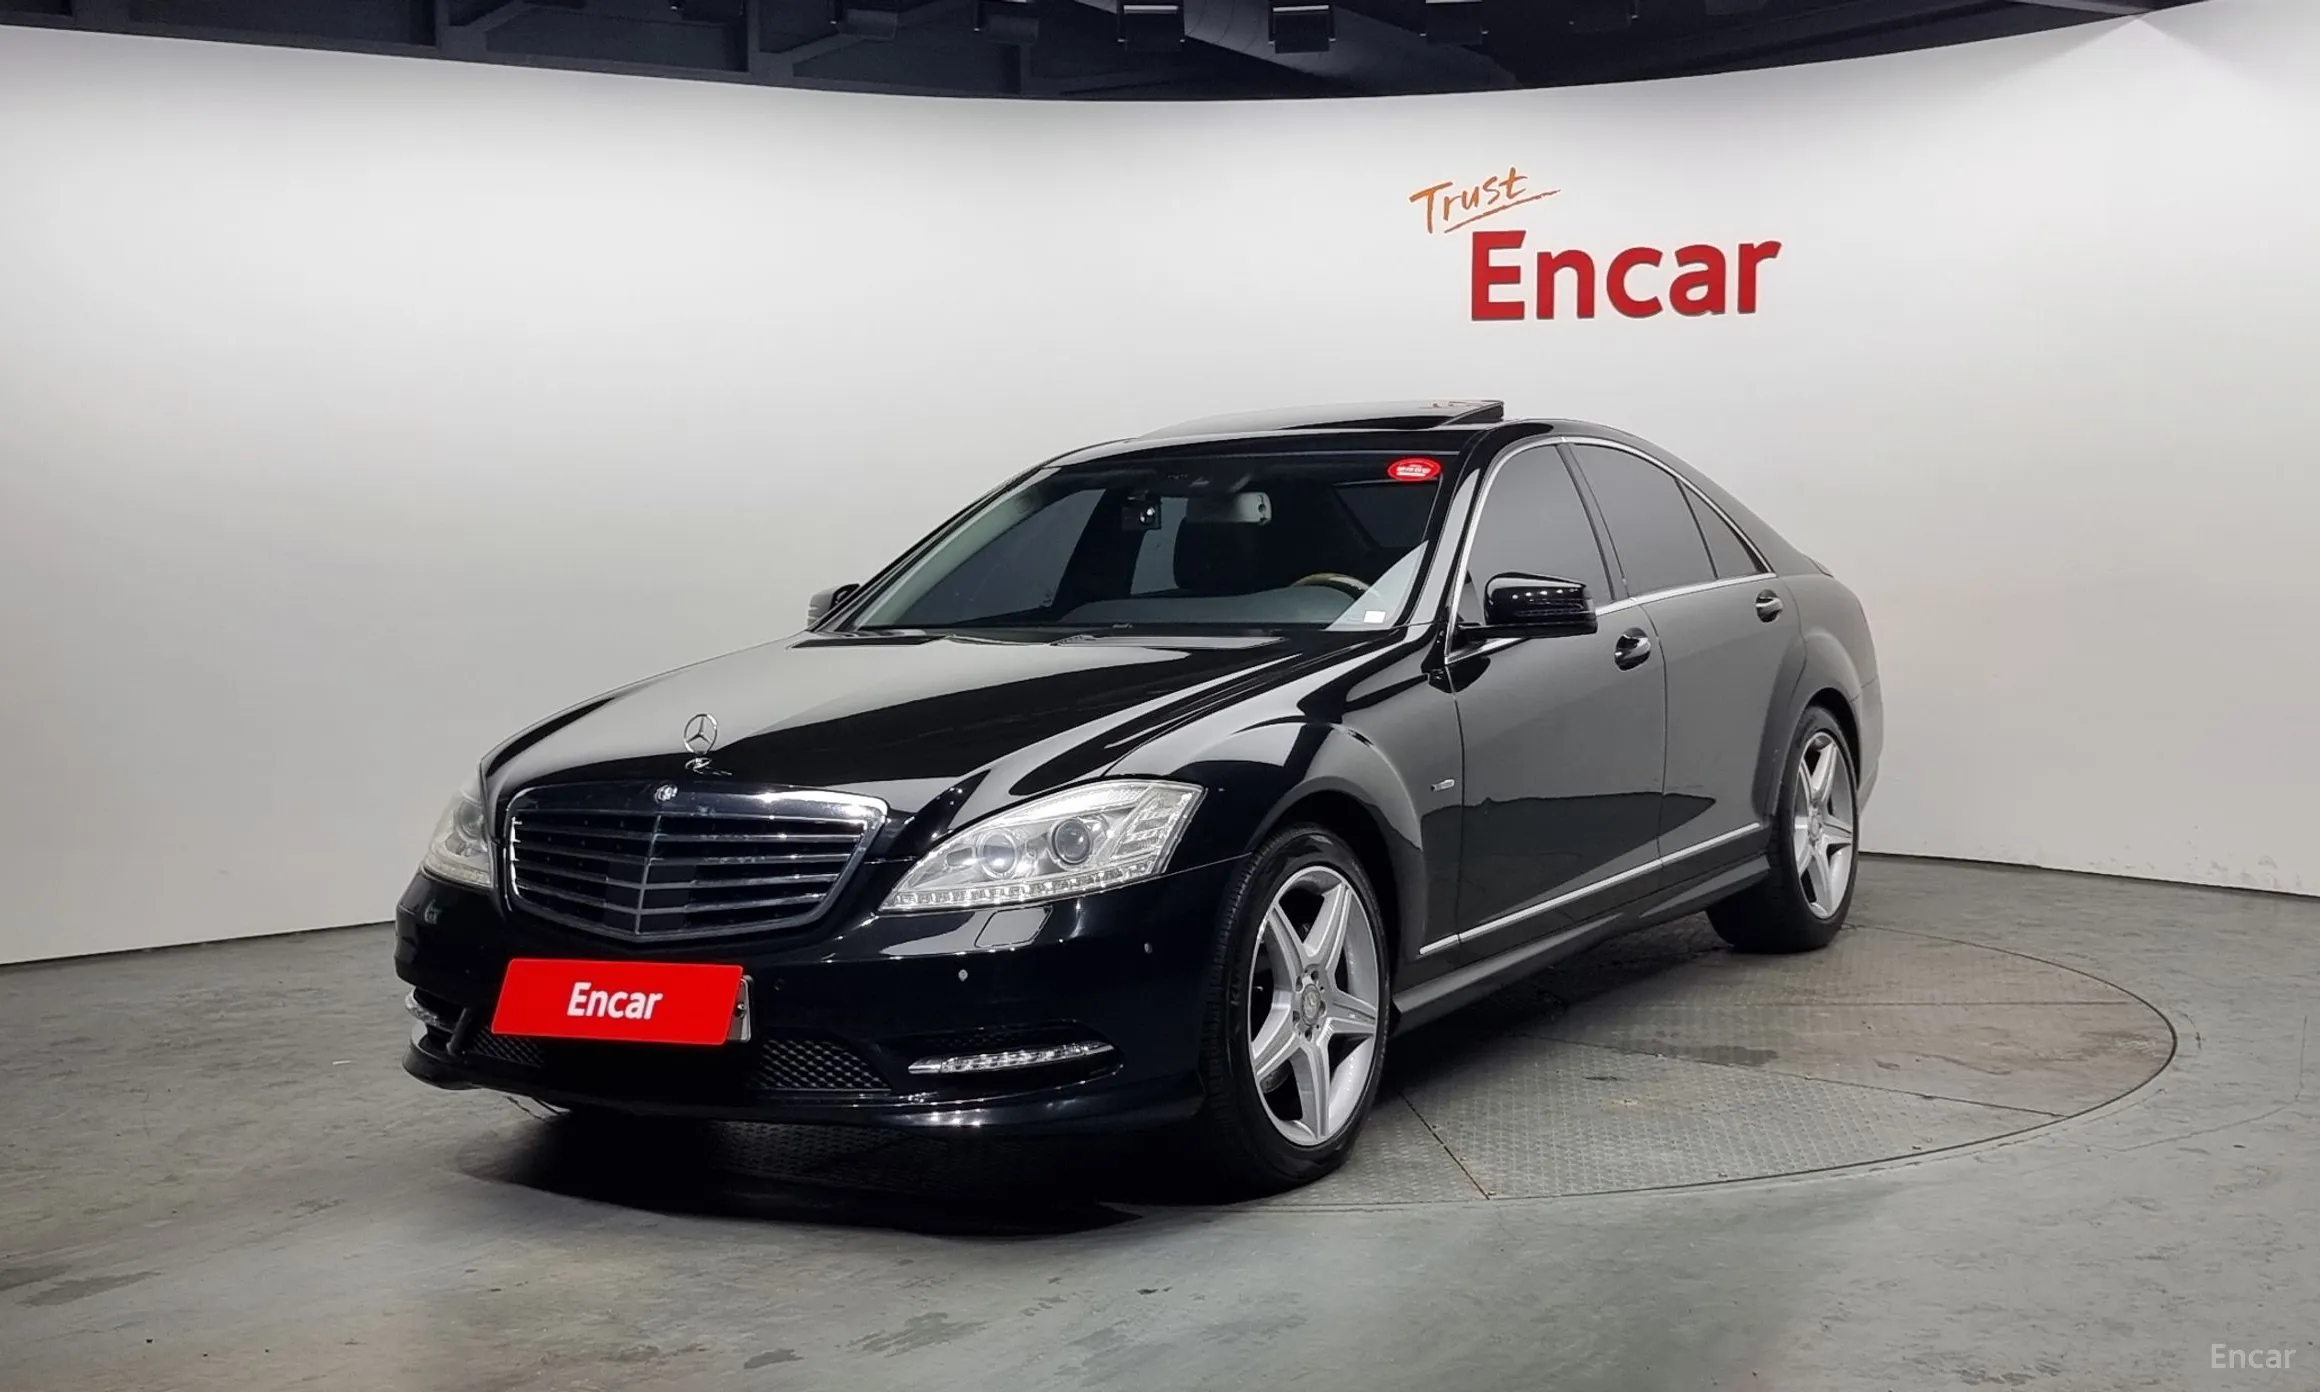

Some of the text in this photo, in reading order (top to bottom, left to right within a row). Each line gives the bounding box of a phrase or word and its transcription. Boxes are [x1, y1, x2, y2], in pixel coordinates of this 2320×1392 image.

[1409, 167, 1528, 233] Trust
[1471, 230, 1782, 321] Encar
[566, 981, 663, 1020] Encar
